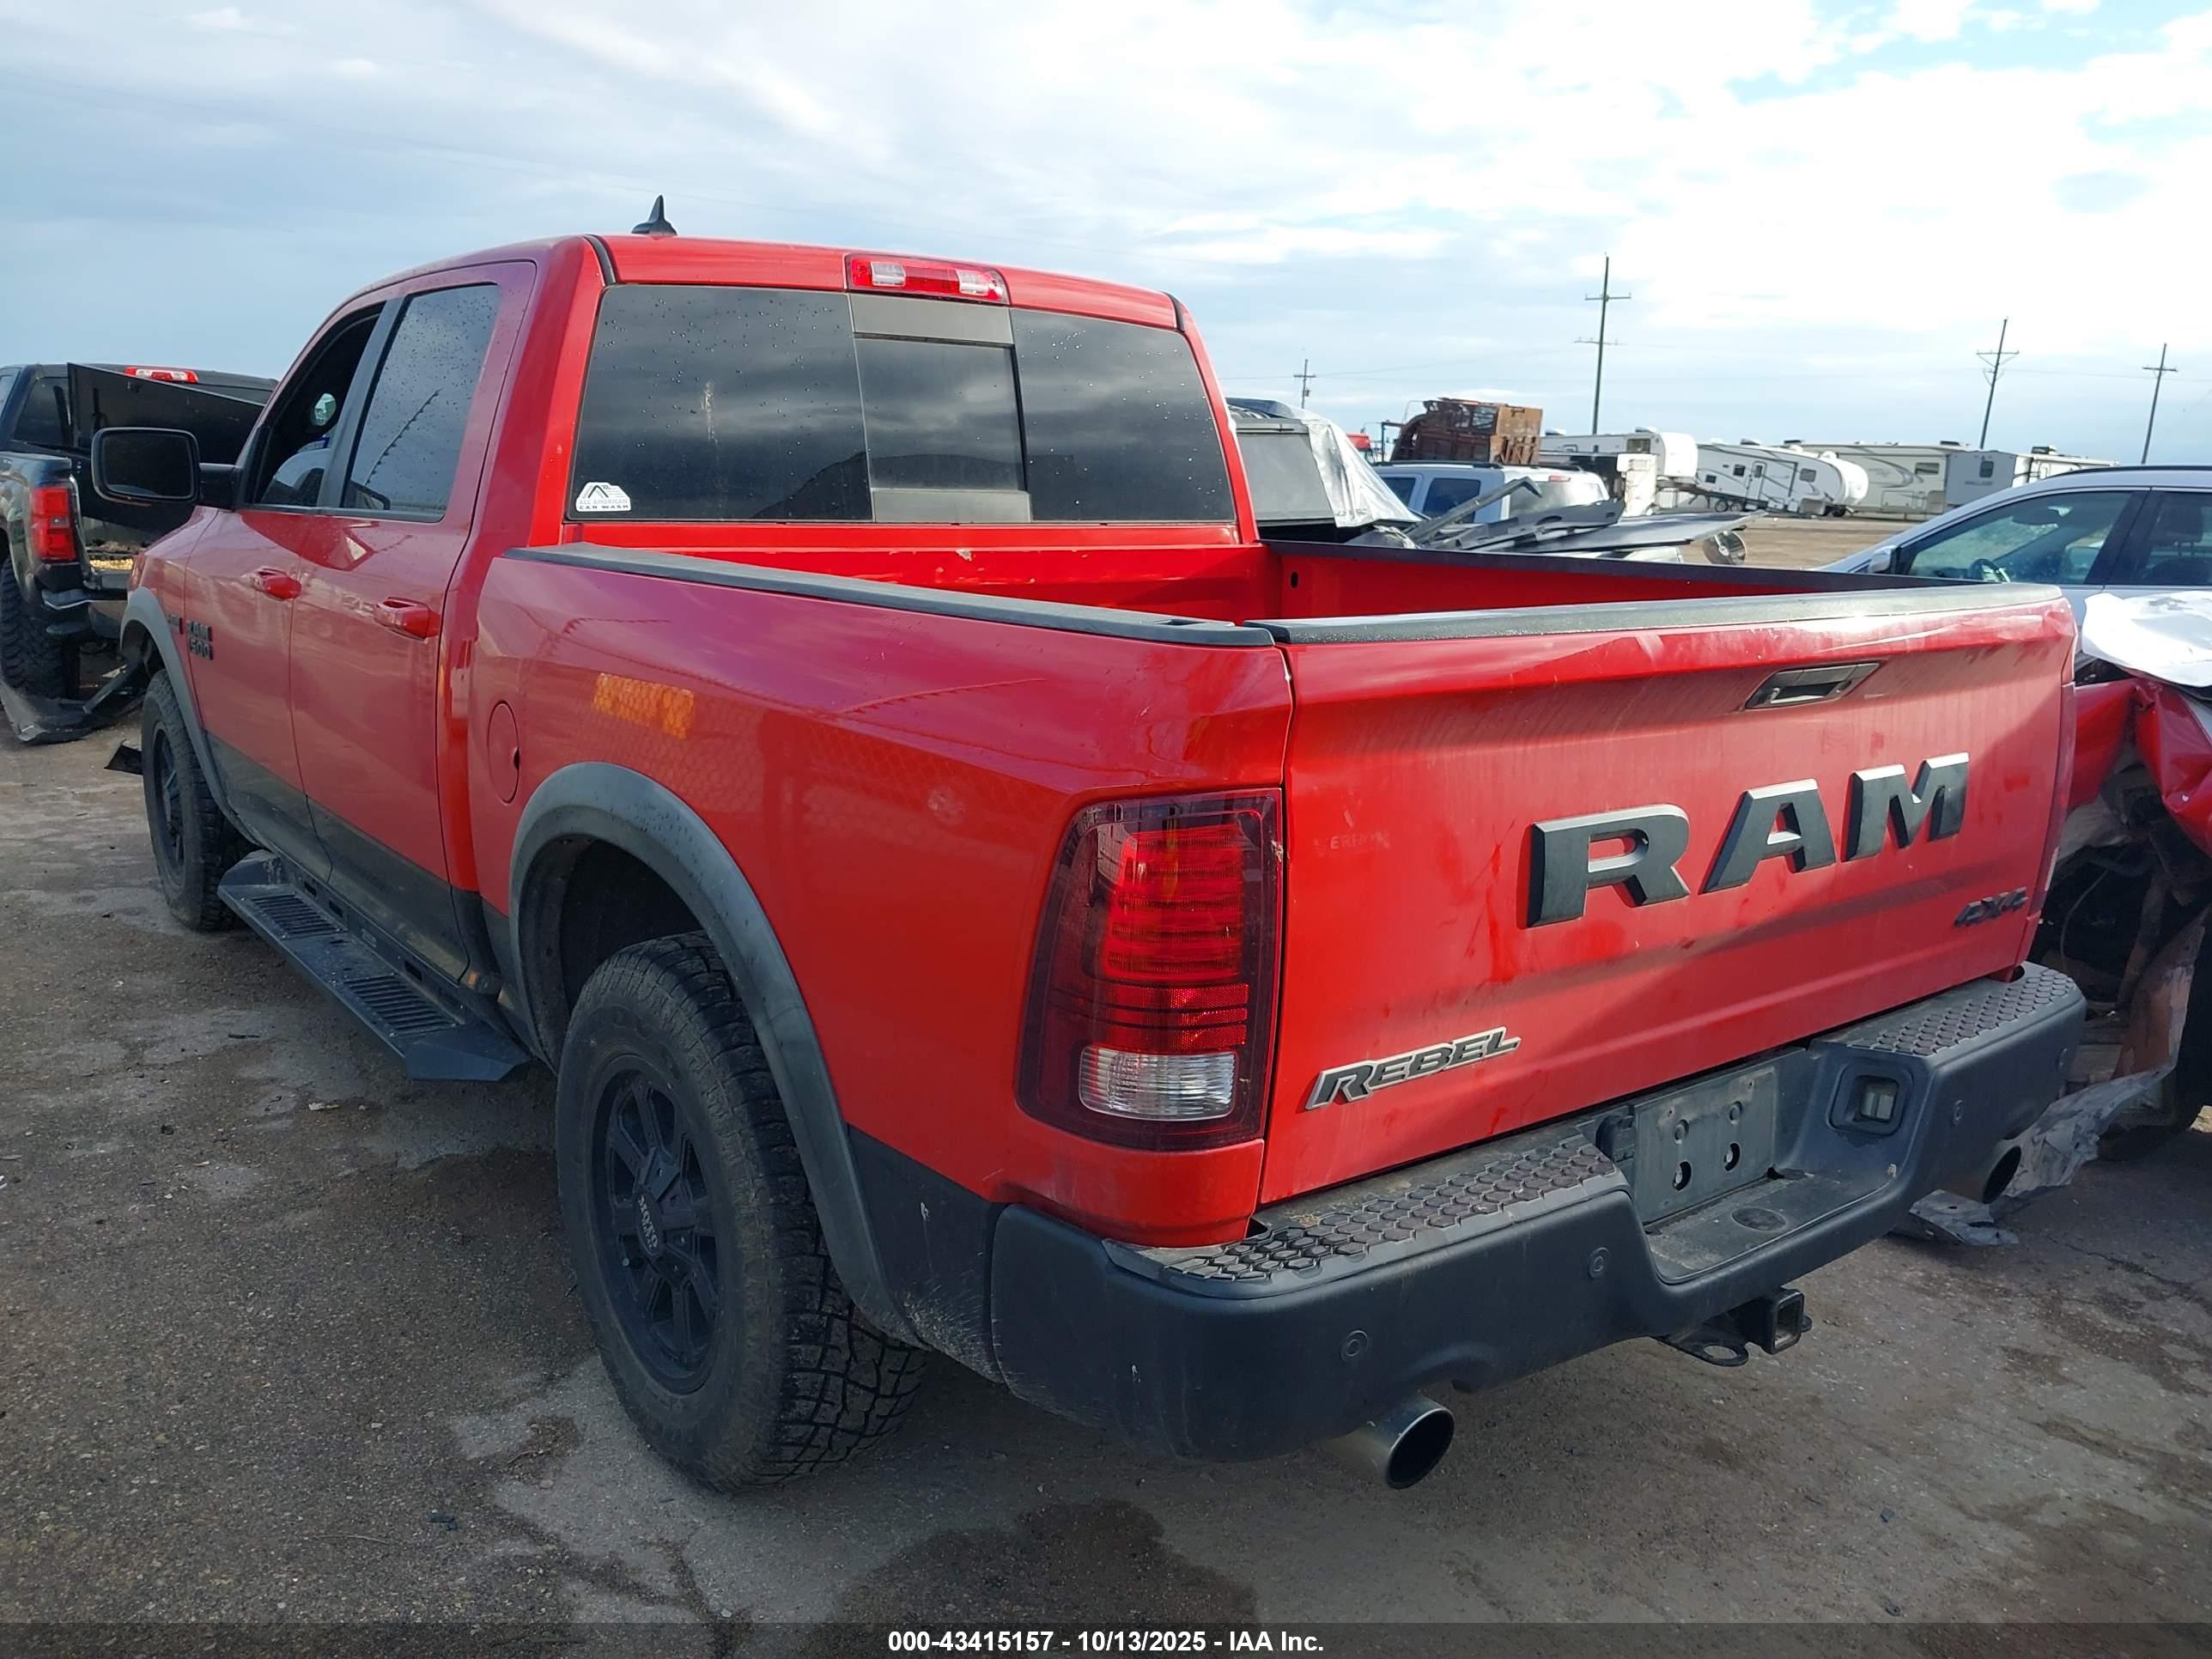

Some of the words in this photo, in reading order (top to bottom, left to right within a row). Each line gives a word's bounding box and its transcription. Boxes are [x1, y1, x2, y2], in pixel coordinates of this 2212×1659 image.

[189, 638, 214, 660] 500
[1526, 751, 1970, 928] RAM
[1304, 1025, 1522, 1111] REBEL
